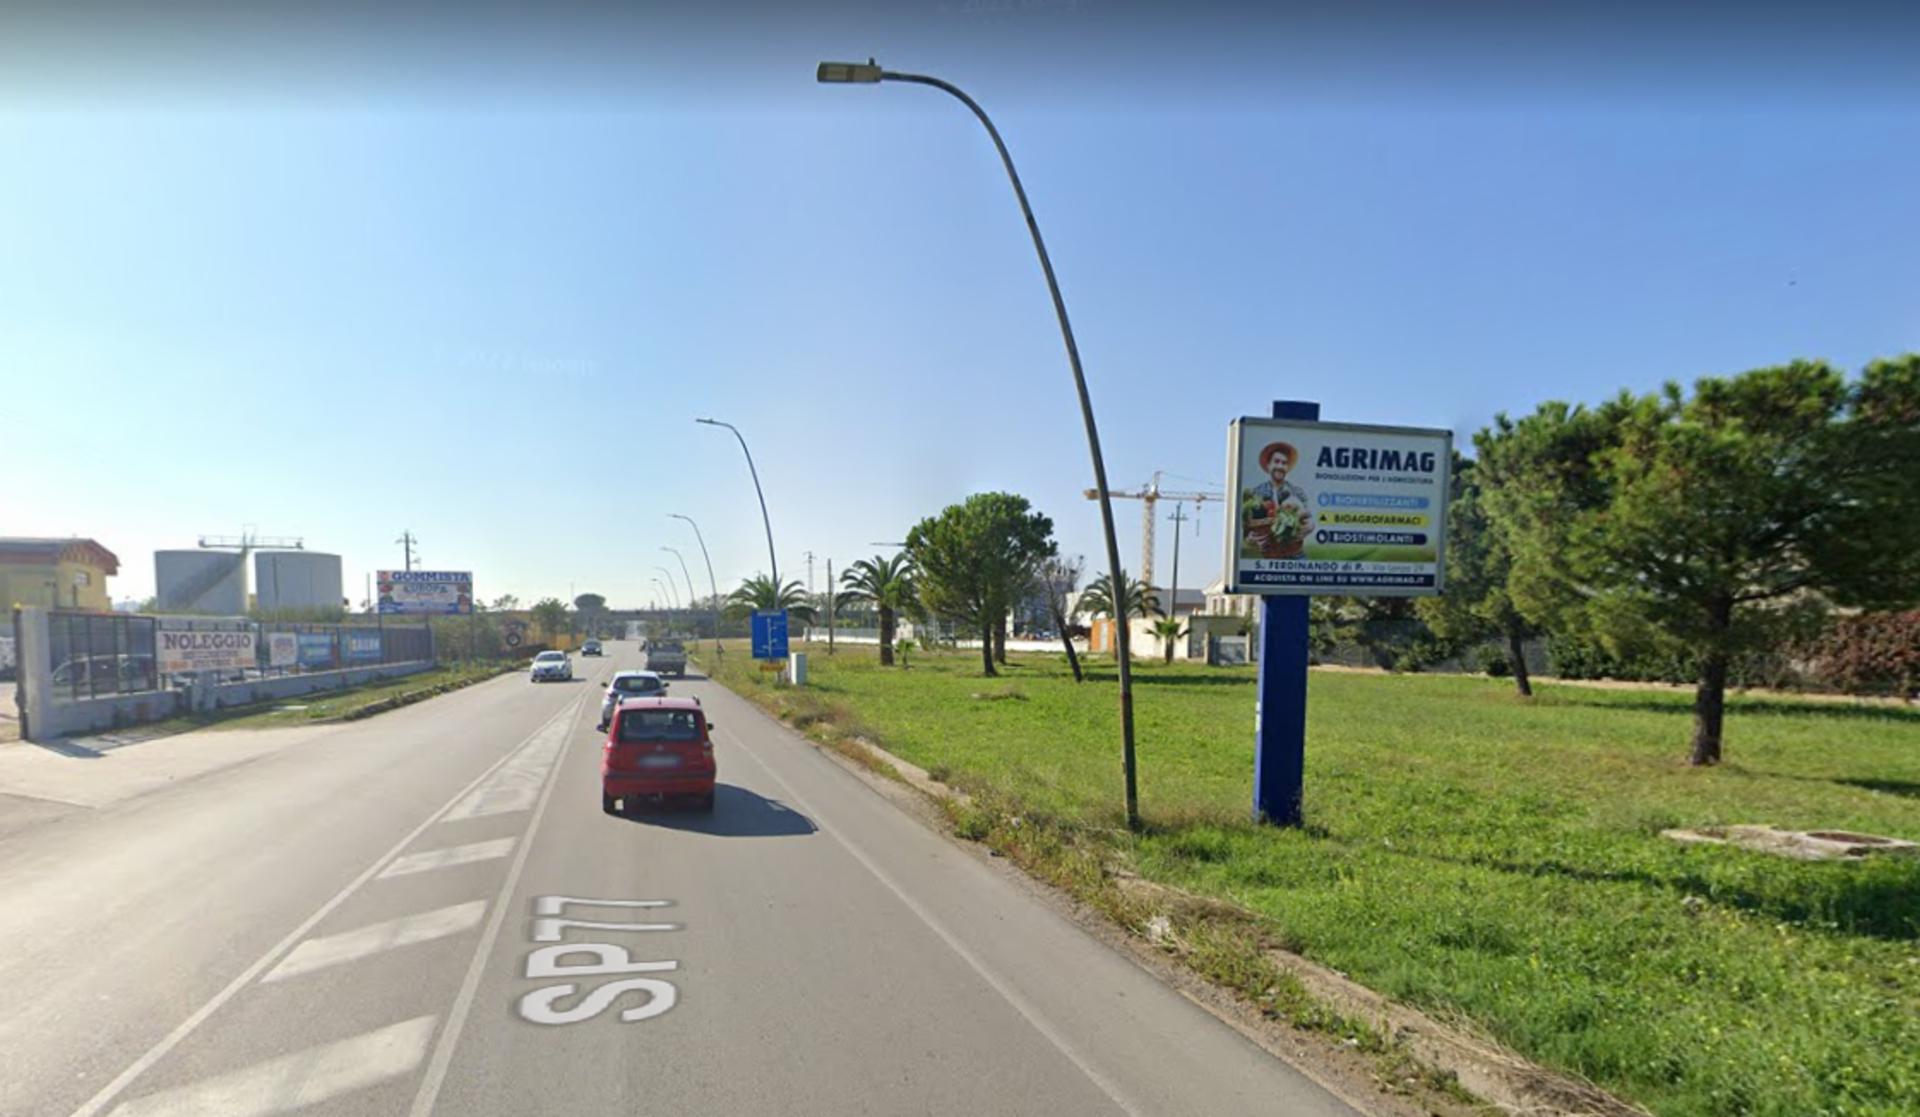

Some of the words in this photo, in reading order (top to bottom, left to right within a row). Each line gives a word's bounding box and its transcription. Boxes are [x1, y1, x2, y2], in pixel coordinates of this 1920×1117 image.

[1316, 446, 1435, 473] AGRIMAG
[1368, 474, 1380, 482] PER
[1335, 495, 1418, 508] BIOFERTILIZZANTI
[1334, 514, 1421, 526] BIOAGROFARMACI
[1333, 532, 1413, 544] BIOSTIMOLANTI
[1255, 560, 1265, 570] S.
[1268, 560, 1338, 571] FERDINANDO
[1341, 562, 1352, 571] di
[1355, 563, 1364, 571] P.
[392, 571, 469, 582] GOMMISTA
[1254, 573, 1297, 581] ACQUISTA
[1299, 574, 1313, 582] ON
[1336, 575, 1348, 583] SU
[1350, 575, 1425, 584] WWW.AGRIMAG.IT
[163, 633, 251, 650] NOLEGGIO
